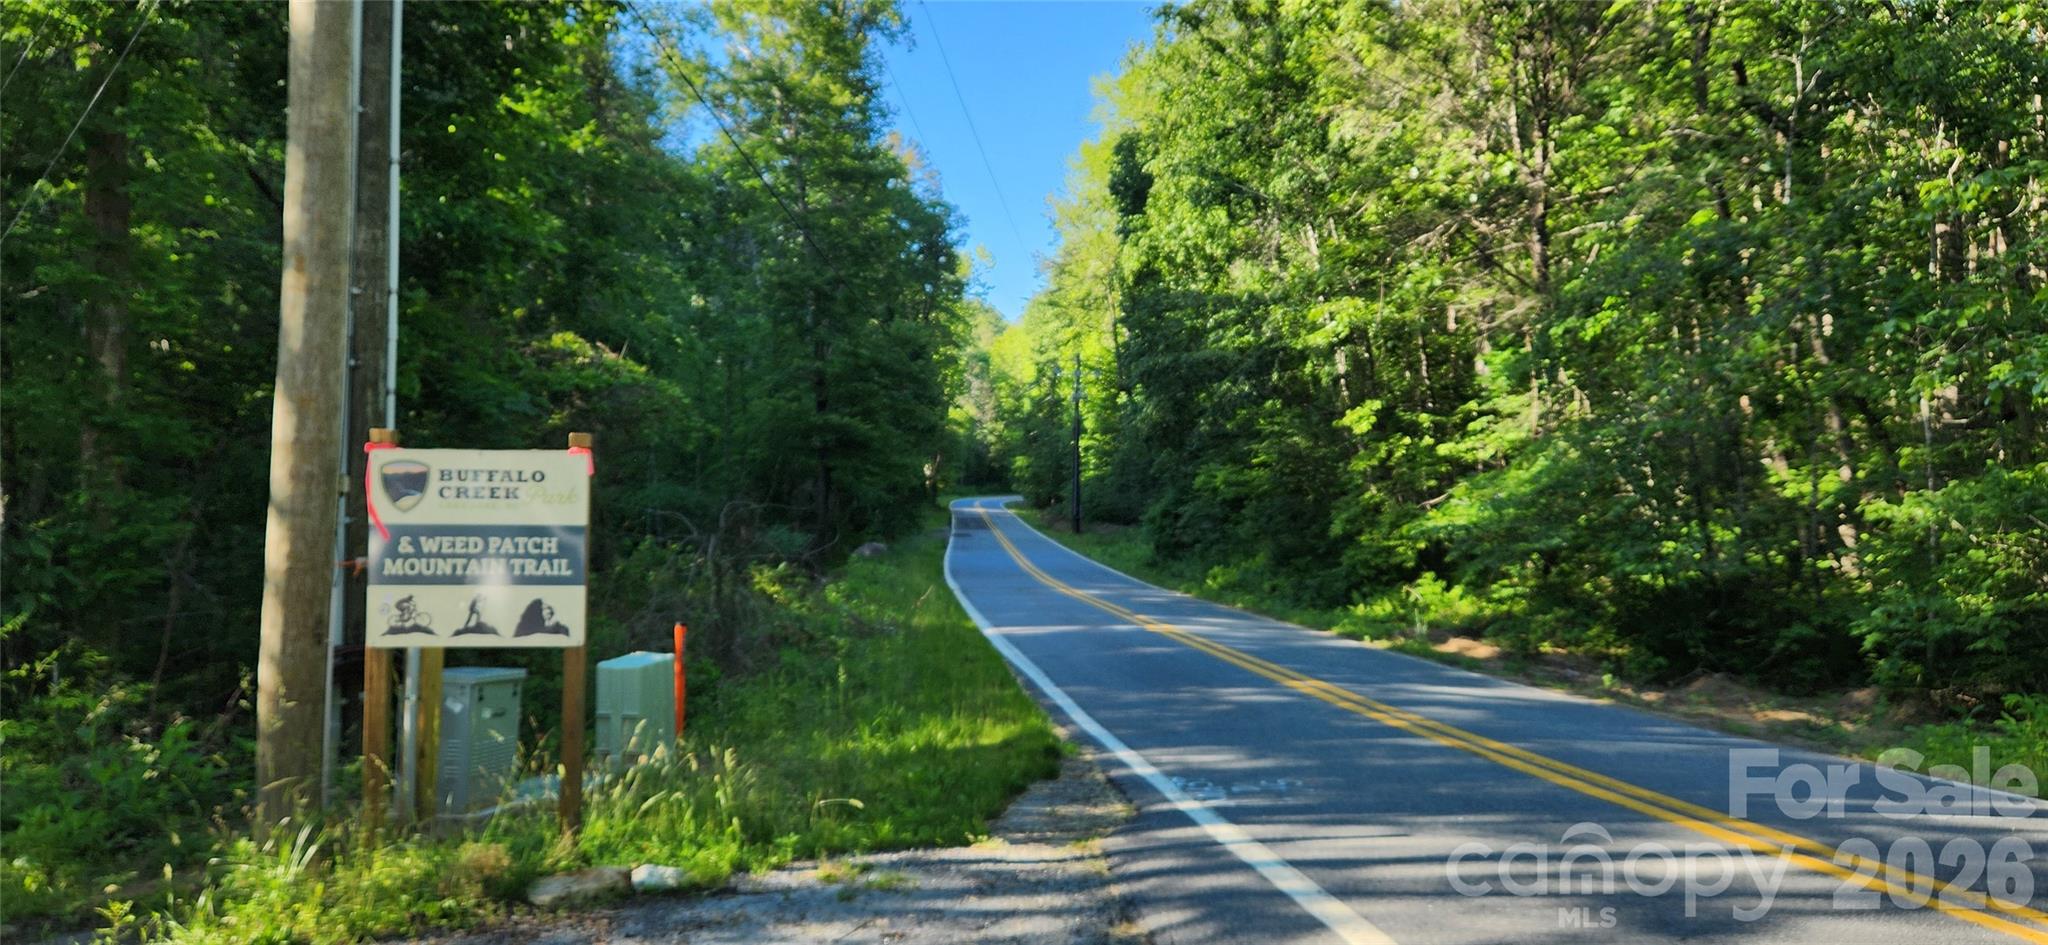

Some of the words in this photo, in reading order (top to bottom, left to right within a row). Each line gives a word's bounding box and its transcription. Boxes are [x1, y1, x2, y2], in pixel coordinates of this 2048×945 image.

[438, 469, 546, 483] BUFFALO
[438, 486, 520, 499] CREEK
[397, 536, 415, 554] &
[419, 536, 485, 554] WEED
[488, 536, 559, 555] PATCH
[382, 558, 507, 576] MOUNTAIN
[511, 559, 573, 576] TRAIL
